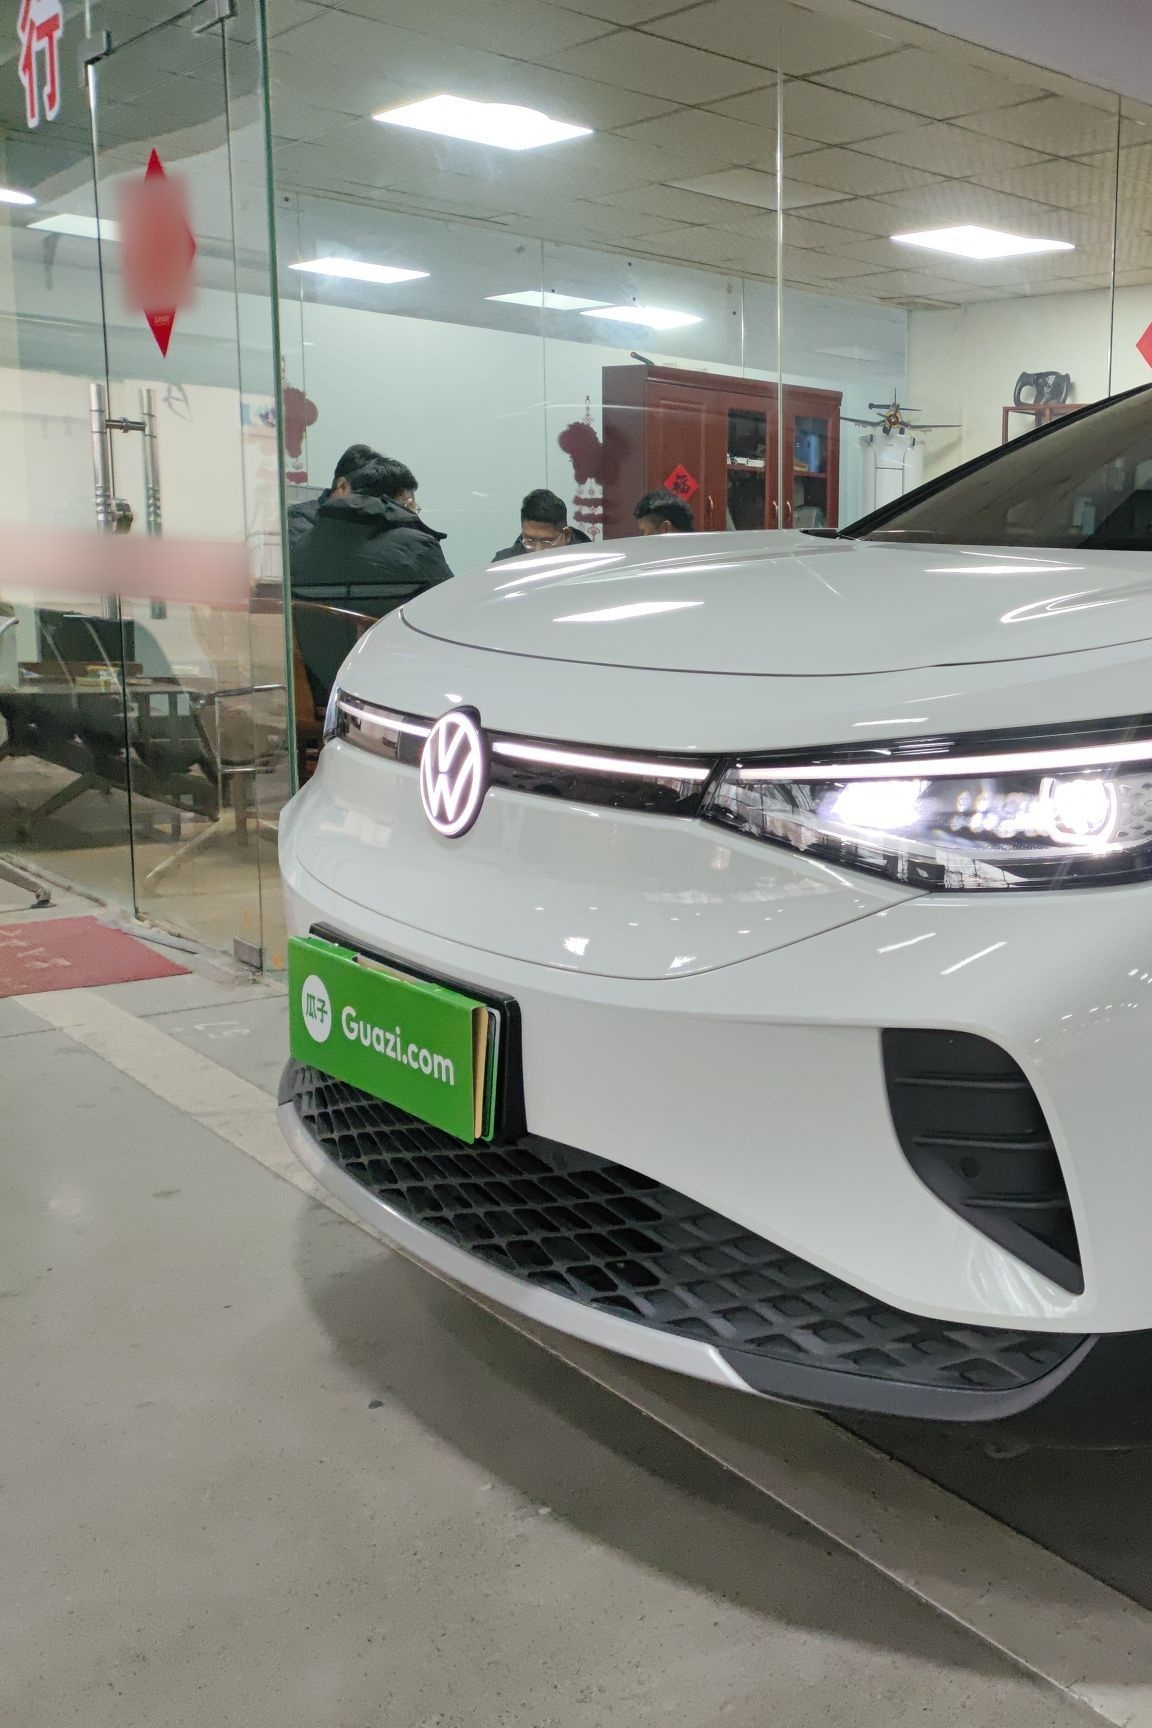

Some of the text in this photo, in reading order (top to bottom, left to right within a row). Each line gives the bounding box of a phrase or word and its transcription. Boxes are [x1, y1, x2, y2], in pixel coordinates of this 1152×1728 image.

[19, 0, 62, 121] 行
[305, 992, 329, 1024] 瓜子
[341, 1005, 455, 1087] Guazi.com
